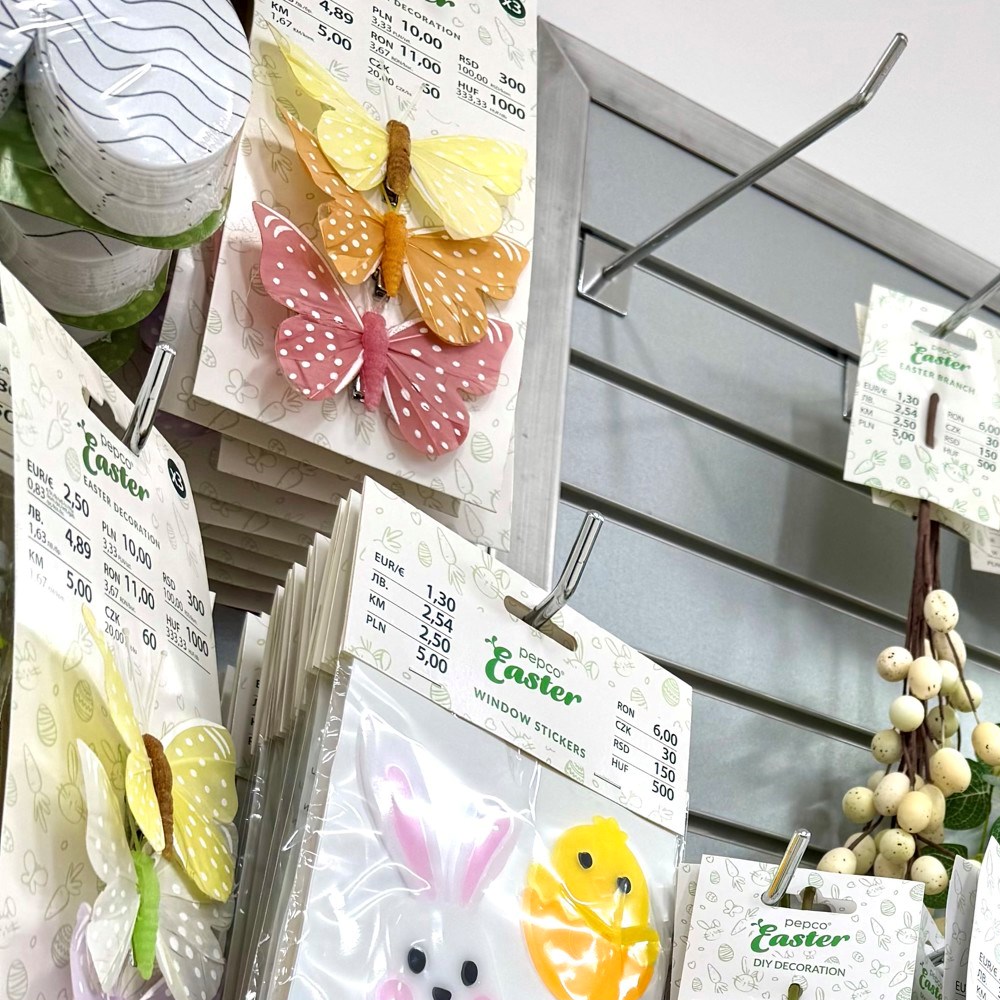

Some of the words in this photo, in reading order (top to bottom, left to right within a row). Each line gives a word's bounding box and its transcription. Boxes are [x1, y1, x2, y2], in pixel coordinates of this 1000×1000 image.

[271, 12, 292, 28] 1,67
[271, 1, 289, 16] KM
[317, 24, 352, 51] 5,00
[319, 0, 354, 25] 4,89
[371, 16, 392, 33] 3,33
[372, 5, 393, 23] PLN
[401, 19, 443, 50] 10,00
[394, 0, 461, 41] DECORATION
[370, 41, 391, 57] 3,67
[371, 31, 394, 50] RON
[400, 44, 442, 75] 11,00
[458, 63, 488, 85] 100,00
[459, 54, 479, 69] RSD
[499, 72, 526, 94] 300
[456, 88, 487, 109] 333,33
[457, 80, 479, 96] HUF
[490, 93, 526, 120] 1000
[910, 342, 971, 372] Easter
[899, 362, 935, 380] EASTER
[937, 374, 976, 395] BRANCH
[895, 404, 918, 419] 2,54
[897, 391, 920, 406] 1,30
[892, 428, 915, 443] 5,00
[893, 417, 917, 430] 2,50
[978, 421, 1000, 437] 6,00
[77, 419, 150, 501] Easter
[979, 447, 998, 461] 150
[986, 436, 999, 449] 30
[977, 459, 997, 473] 500
[63, 483, 89, 518] 2,50
[83, 475, 112, 507] EASTER
[113, 502, 161, 550] DECORATION
[29, 522, 47, 544] 1,63
[65, 528, 91, 559] 4,89
[101, 521, 117, 542] PLN
[122, 533, 152, 570] 10,00
[103, 537, 118, 558] 3,33
[28, 549, 44, 569] KM
[66, 570, 92, 603] 5,00
[103, 562, 121, 585] RON
[124, 574, 155, 610] 11,00
[104, 579, 119, 599] 3,67
[374, 551, 405, 578] EUR/€
[425, 584, 457, 613] 1,30
[162, 571, 176, 591] RSD
[186, 589, 205, 617] 300
[104, 605, 121, 627] CZK
[142, 628, 157, 651] 60
[104, 621, 124, 645] 20,00
[166, 613, 180, 633] HUF
[186, 625, 209, 657] 1000
[369, 594, 386, 611] KM
[419, 625, 451, 654] 2,50
[421, 604, 454, 633] 2,54
[365, 615, 387, 634] PLN
[415, 646, 448, 675] 5,00
[485, 636, 582, 707] Easter
[473, 686, 532, 726] WINDOW
[534, 720, 586, 760] STICKERS
[616, 700, 636, 719] RON
[653, 723, 678, 748] 6,00
[615, 720, 632, 737] CZK
[661, 746, 677, 765] 30
[612, 738, 631, 755] RSD
[653, 761, 676, 784] 150
[611, 757, 629, 774] HUF
[651, 780, 675, 802] 500
[750, 918, 851, 953] Easter
[753, 958, 773, 970] DIY
[774, 960, 846, 978] DECORATION
